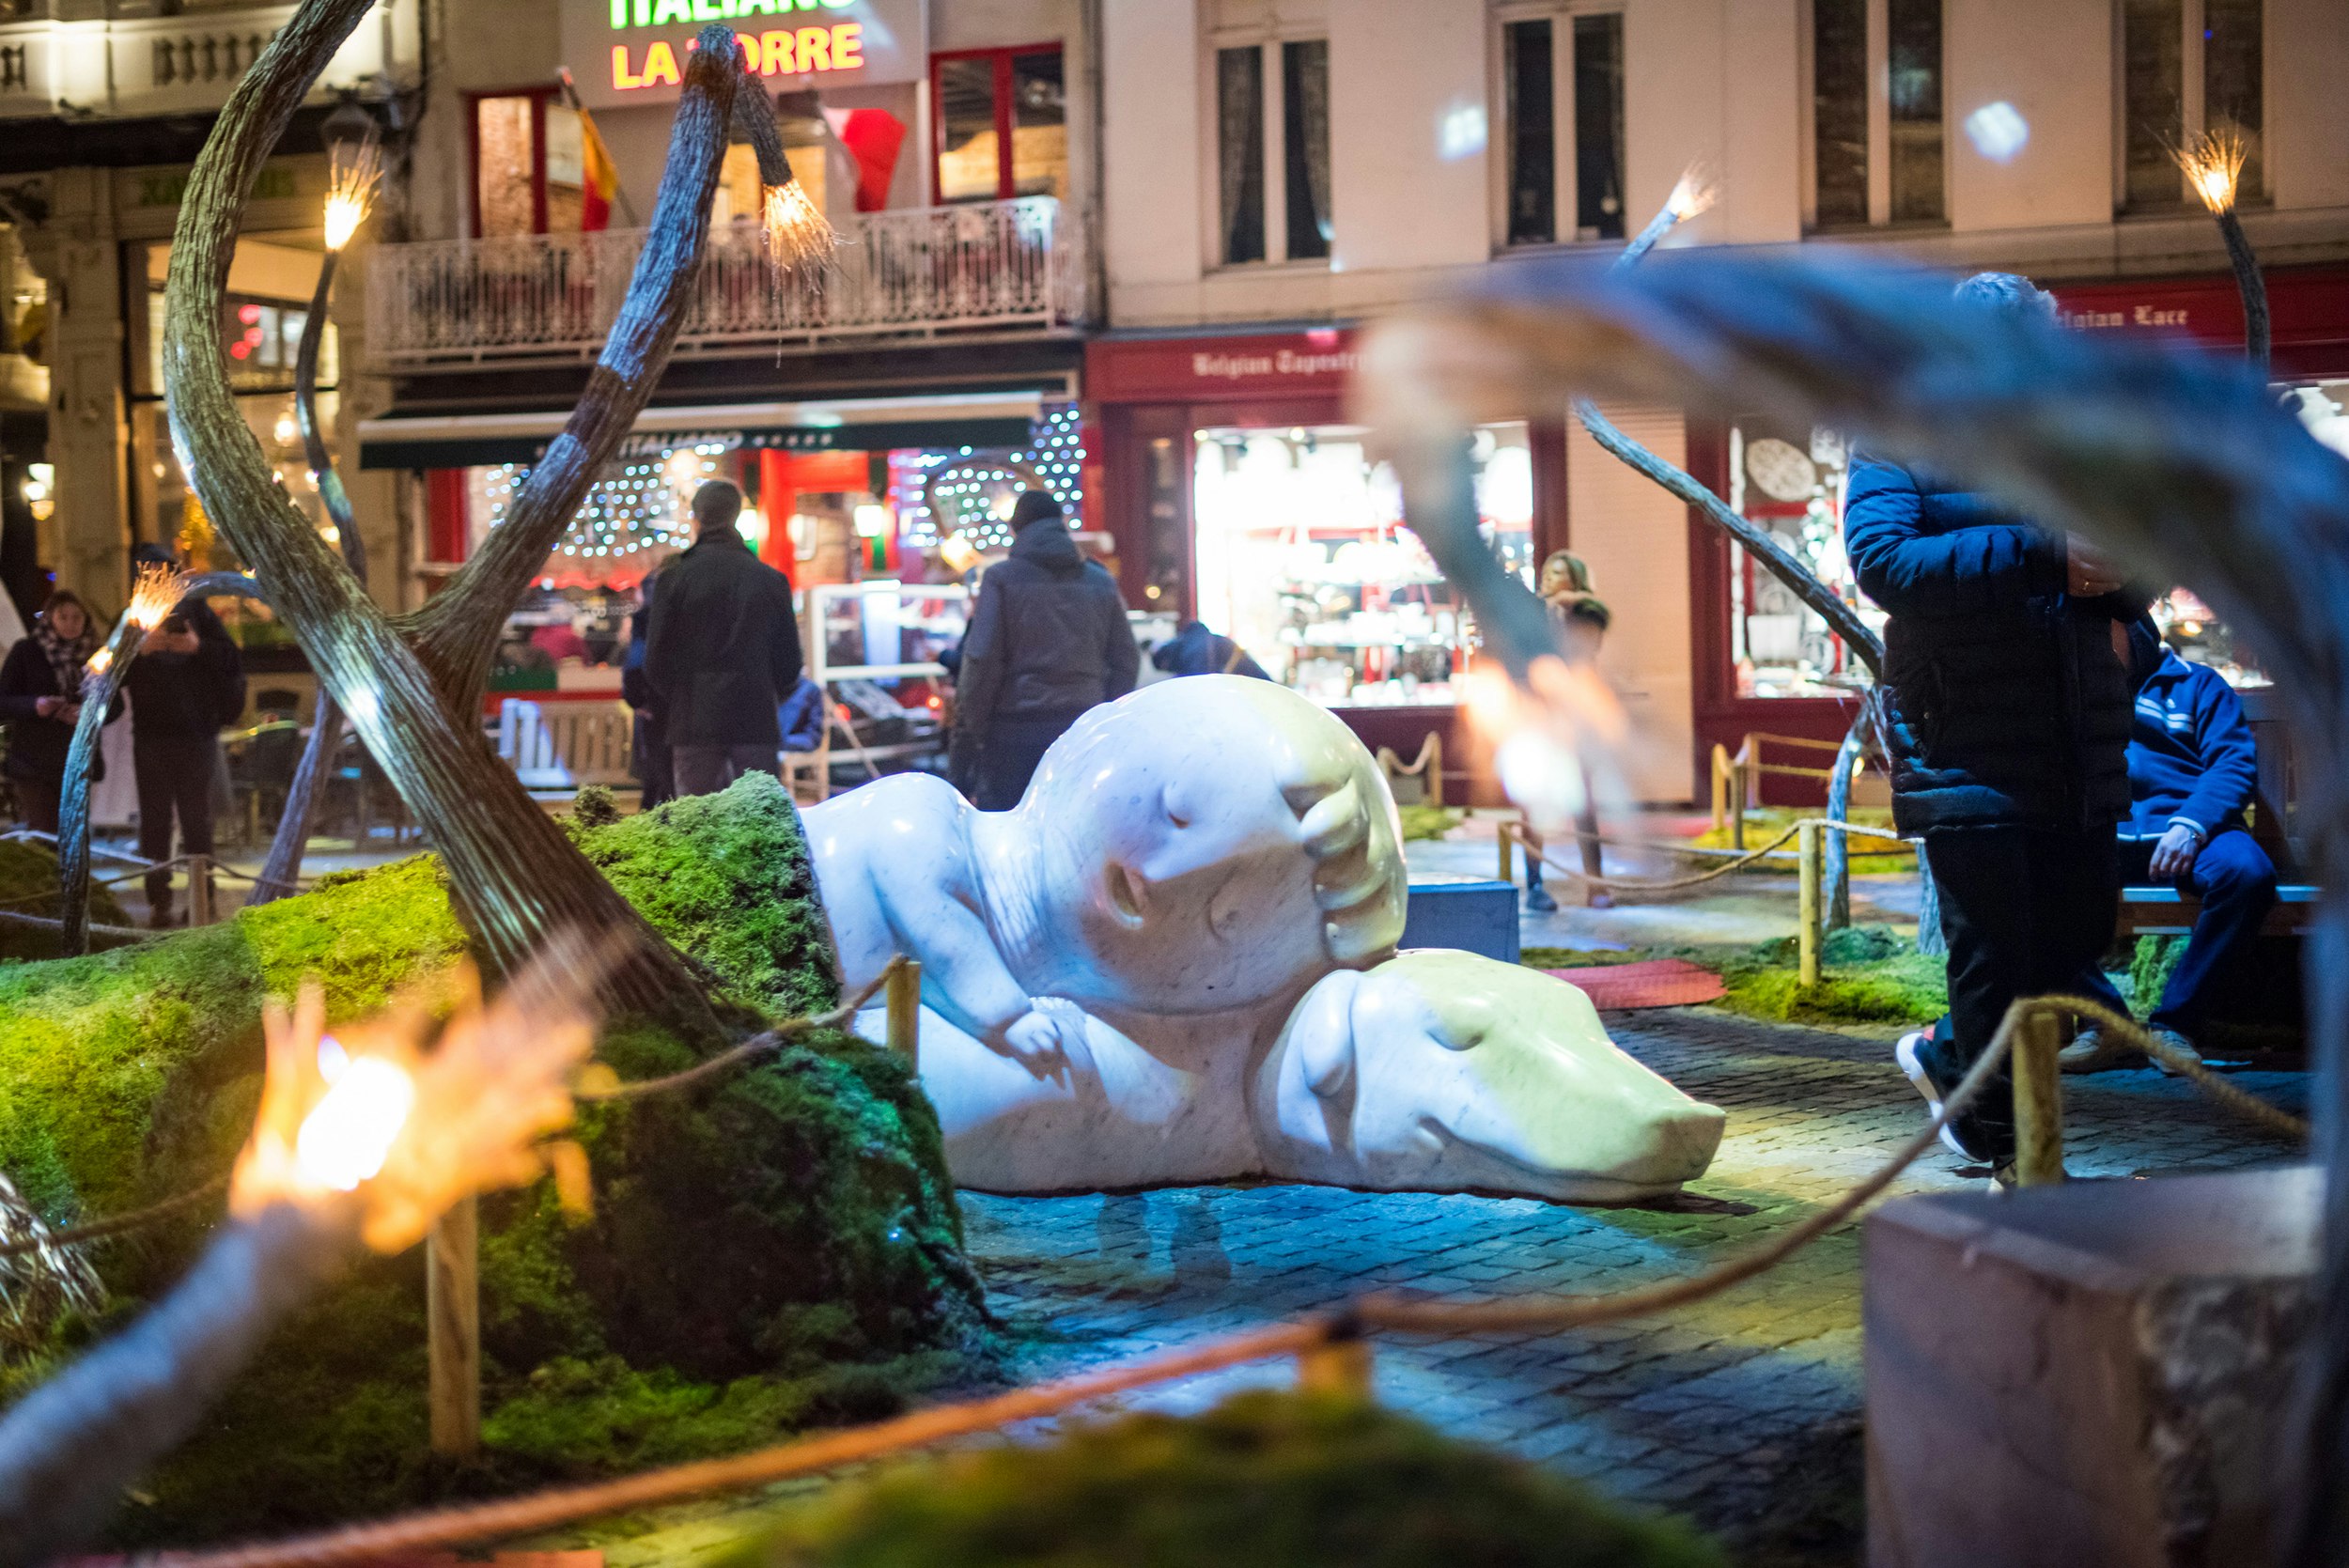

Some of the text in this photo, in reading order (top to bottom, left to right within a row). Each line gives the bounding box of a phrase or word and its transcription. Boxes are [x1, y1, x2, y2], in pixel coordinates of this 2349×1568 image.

[613, 23, 864, 90] LA ORRE
[2054, 304, 2188, 332] lgian Lace
[1192, 351, 1272, 380] Belgian
